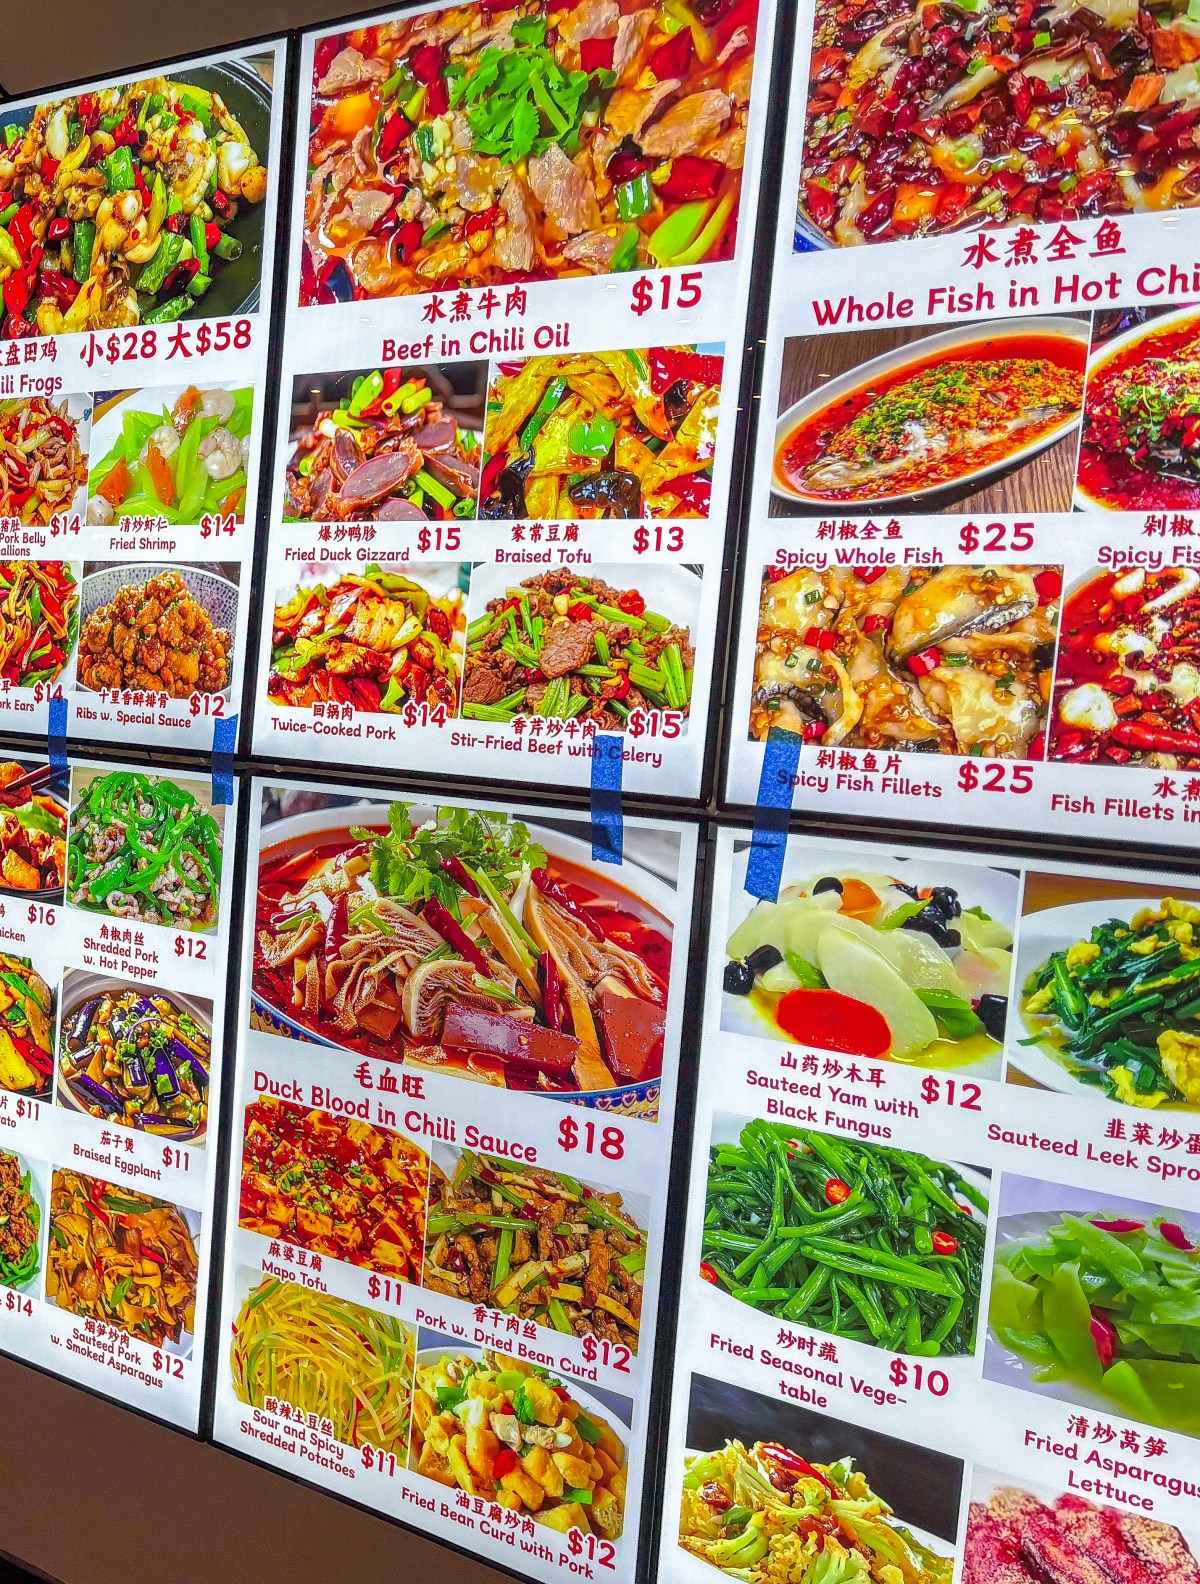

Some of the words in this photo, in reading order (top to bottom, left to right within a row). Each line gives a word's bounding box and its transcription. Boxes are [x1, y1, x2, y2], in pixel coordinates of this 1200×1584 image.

[961, 220, 1126, 269] 水煮全鱼
[422, 286, 526, 324] 水煮牛肉
[631, 272, 702, 316] $15
[812, 292, 913, 326] Whole
[928, 282, 994, 315] Fish
[1009, 283, 1038, 307] in
[1054, 272, 1122, 300] Hot
[382, 334, 433, 361] Beef
[441, 336, 460, 356] in
[470, 327, 524, 354] Chili
[534, 323, 569, 349] Oil
[20, 374, 62, 396] Frogs
[50, 515, 80, 537] $14
[200, 516, 235, 539] $14
[418, 527, 460, 553] $15
[512, 523, 579, 543] 家常豆腐
[633, 526, 683, 554] $13
[816, 519, 903, 540] 剁椒全鱼
[959, 522, 1034, 554] $25
[110, 537, 135, 549] Fried
[139, 537, 176, 553] Shrimp
[285, 548, 315, 560] Fried
[320, 548, 351, 560] Duck
[356, 548, 409, 561] Gizzard
[495, 548, 551, 562] Braised
[557, 548, 591, 563] Tofu
[776, 548, 827, 568] Spicy
[835, 547, 895, 564] Whole
[904, 547, 943, 563] Fish
[15, 700, 34, 711] Ears
[76, 707, 97, 719] Ribs
[101, 712, 112, 721] w.
[117, 711, 154, 725] Special
[158, 714, 191, 728] Sauce
[190, 694, 224, 716] $12
[314, 703, 352, 721] 回锅肉
[404, 702, 446, 728] $14
[272, 718, 361, 737] Twice-Cooked
[366, 726, 396, 740] Pork
[629, 710, 680, 738] $15
[816, 750, 902, 775] 剁椒鱼片
[958, 761, 1033, 794] $25
[28, 904, 55, 926] $16
[175, 936, 206, 960] $12
[354, 1061, 425, 1099] 毛血旺
[747, 1070, 821, 1098] Sauteed
[828, 1086, 867, 1108] Yam
[874, 1098, 919, 1118] with
[921, 1075, 981, 1111] $12
[16, 1098, 39, 1120] $11
[254, 1071, 303, 1102] Duck
[312, 1086, 370, 1119] Blood
[378, 1102, 396, 1126] in
[405, 1111, 456, 1142] Chili
[465, 1126, 536, 1162] Sauce
[767, 1098, 817, 1122] Black
[825, 1110, 891, 1138] Fungus
[558, 1116, 624, 1160] $18
[74, 1144, 111, 1164] Braised
[115, 1156, 161, 1180] Eggplant
[162, 1146, 189, 1171] $11
[268, 1241, 322, 1272] 麻婆豆腐
[262, 1259, 295, 1281] Mapo
[300, 1272, 327, 1292] Tofu
[368, 1274, 401, 1305] $11
[6, 1291, 32, 1316] $14
[777, 1328, 838, 1363] 炒时蔬
[153, 1350, 183, 1379] $12
[711, 1334, 754, 1360] Fried
[760, 1348, 843, 1388] Seasonal
[889, 1358, 948, 1396] $10
[779, 1380, 826, 1408] table
[362, 1445, 394, 1476] $11
[568, 1529, 615, 1572] $12
